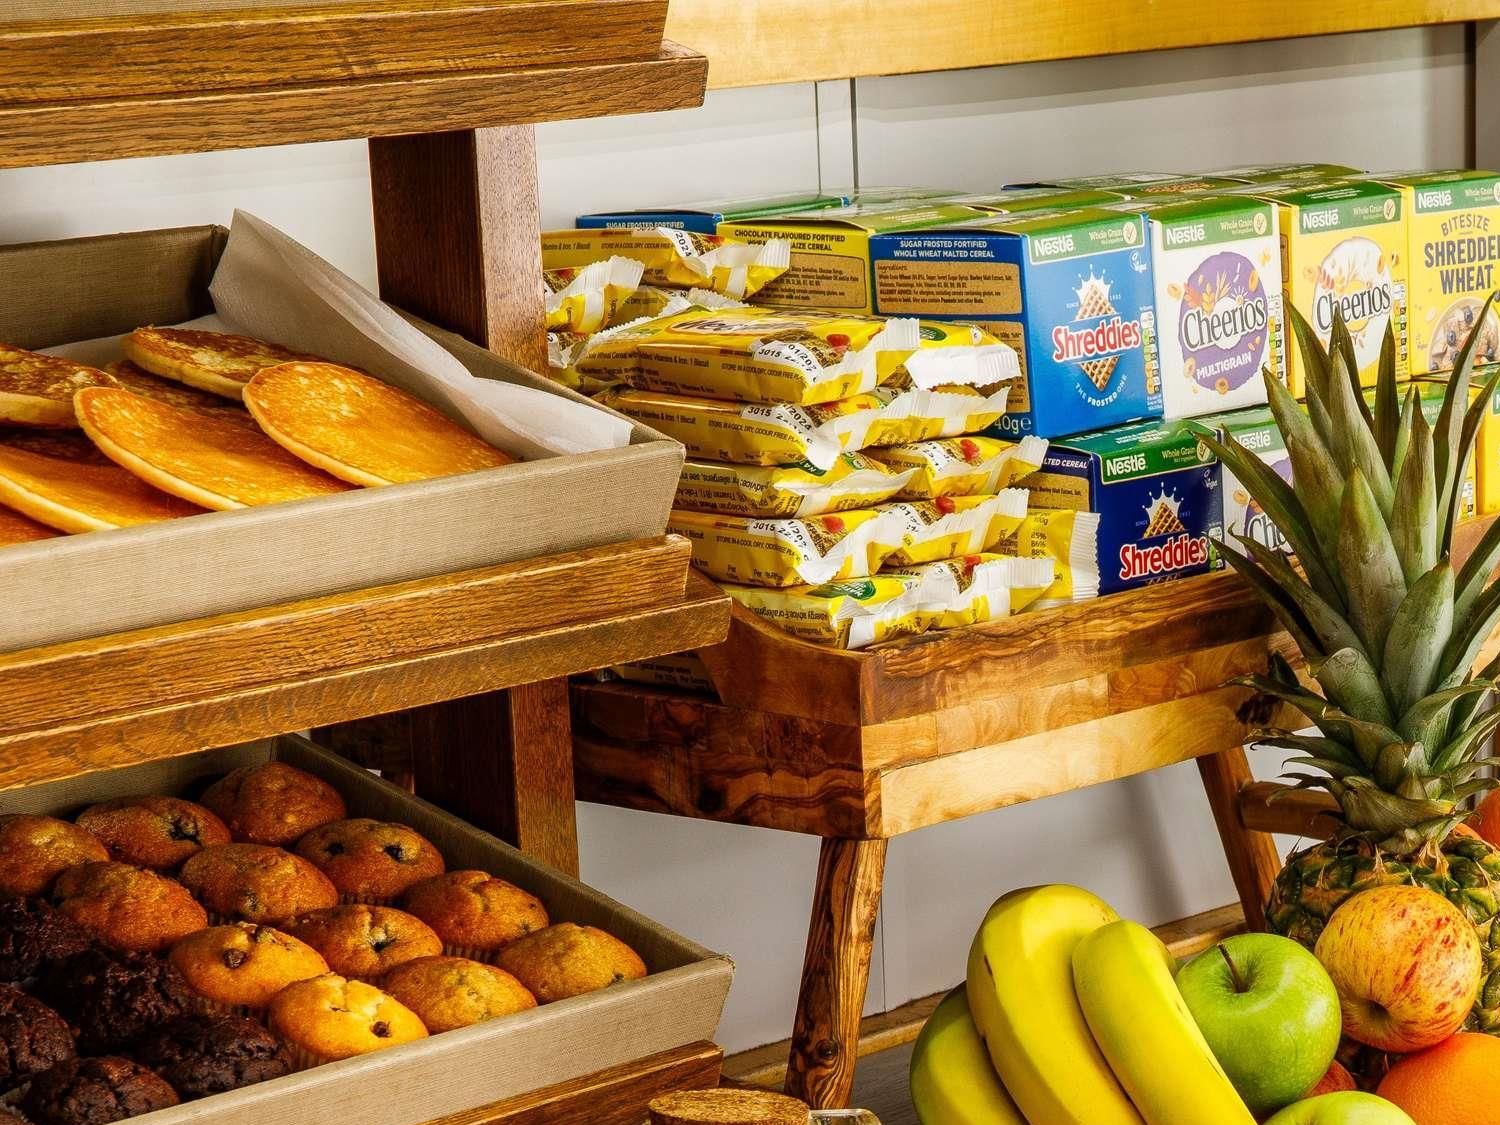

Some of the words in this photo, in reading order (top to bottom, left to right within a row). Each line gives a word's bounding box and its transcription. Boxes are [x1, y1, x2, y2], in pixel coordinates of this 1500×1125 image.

[1440, 213, 1490, 236] BITESIZE
[735, 229, 773, 239] CHOCOLATE
[774, 231, 812, 241] FLAVOURED
[812, 233, 846, 242] FORTIFIED
[790, 242, 806, 250] AIZE
[807, 243, 832, 251] CEREAL
[899, 240, 922, 248] SUGAR
[923, 240, 952, 248] FROSTED
[953, 240, 987, 248] FORTIFIED
[893, 250, 917, 258] WHOLE
[918, 250, 941, 258] WHEAT
[943, 250, 968, 258] MALTED
[969, 250, 995, 258] CEREAL
[1440, 264, 1493, 295] WHEAT
[1316, 283, 1391, 331] Cheerios
[1183, 299, 1266, 350] Cheerios
[1052, 316, 1141, 362] Shreddies
[758, 348, 782, 358] 3015
[1196, 351, 1253, 381] MULTIGRAIN
[1087, 392, 1117, 408] FROSTED
[747, 406, 772, 417] 3015
[1161, 448, 1179, 459] Whole
[1043, 457, 1061, 467] LTED
[1062, 459, 1089, 469] CEREAL
[753, 522, 776, 532] 3015
[1119, 533, 1208, 580] Shreddies
